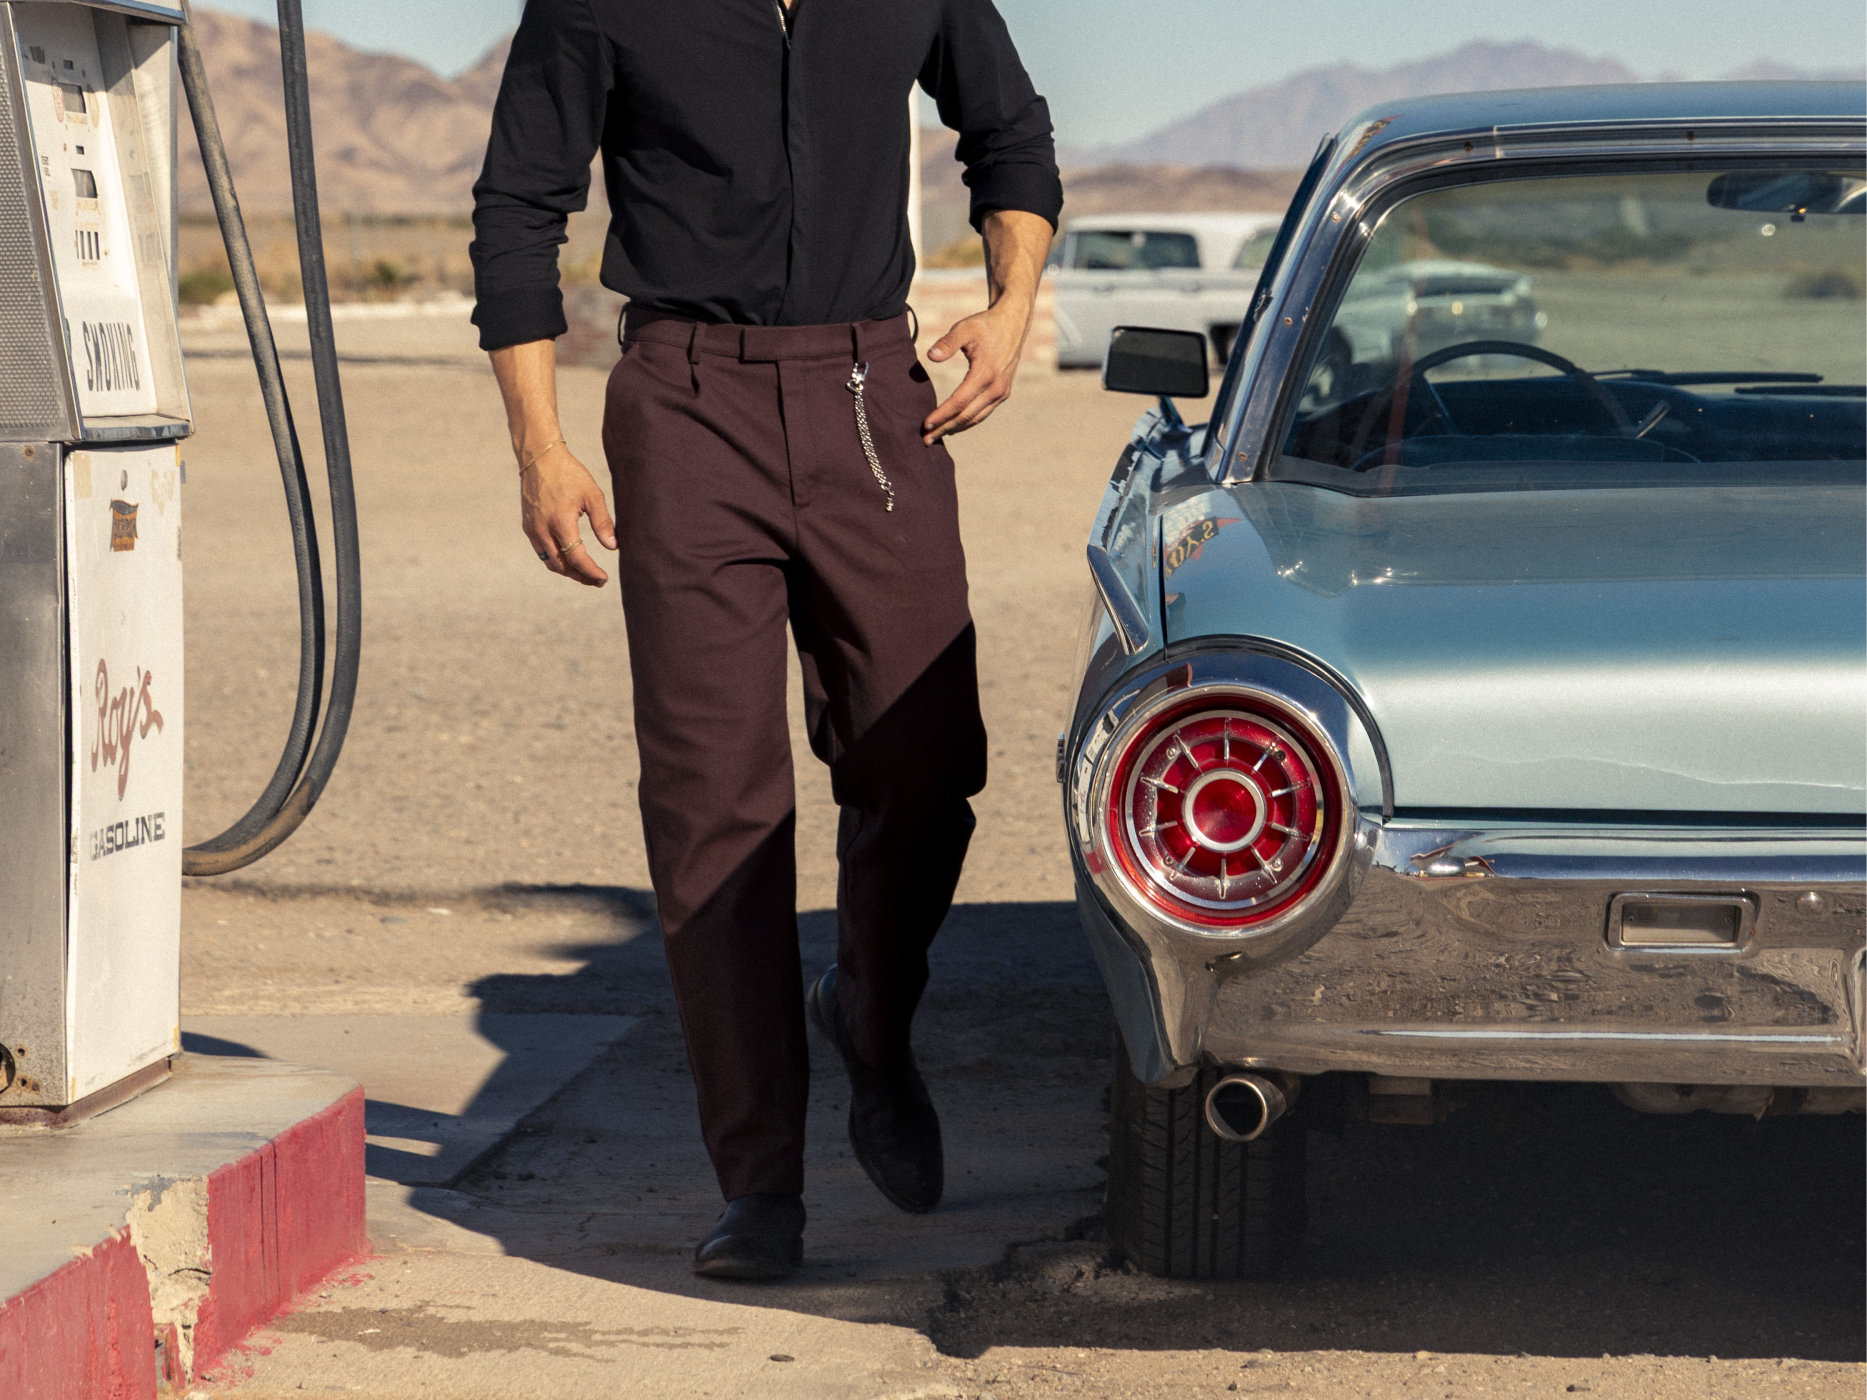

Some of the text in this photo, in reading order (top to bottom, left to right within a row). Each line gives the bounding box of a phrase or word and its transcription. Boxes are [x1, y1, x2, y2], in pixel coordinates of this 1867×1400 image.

[82, 320, 141, 392] SMOKING
[91, 658, 164, 802] Roy's
[90, 811, 166, 861] GASOLINE
